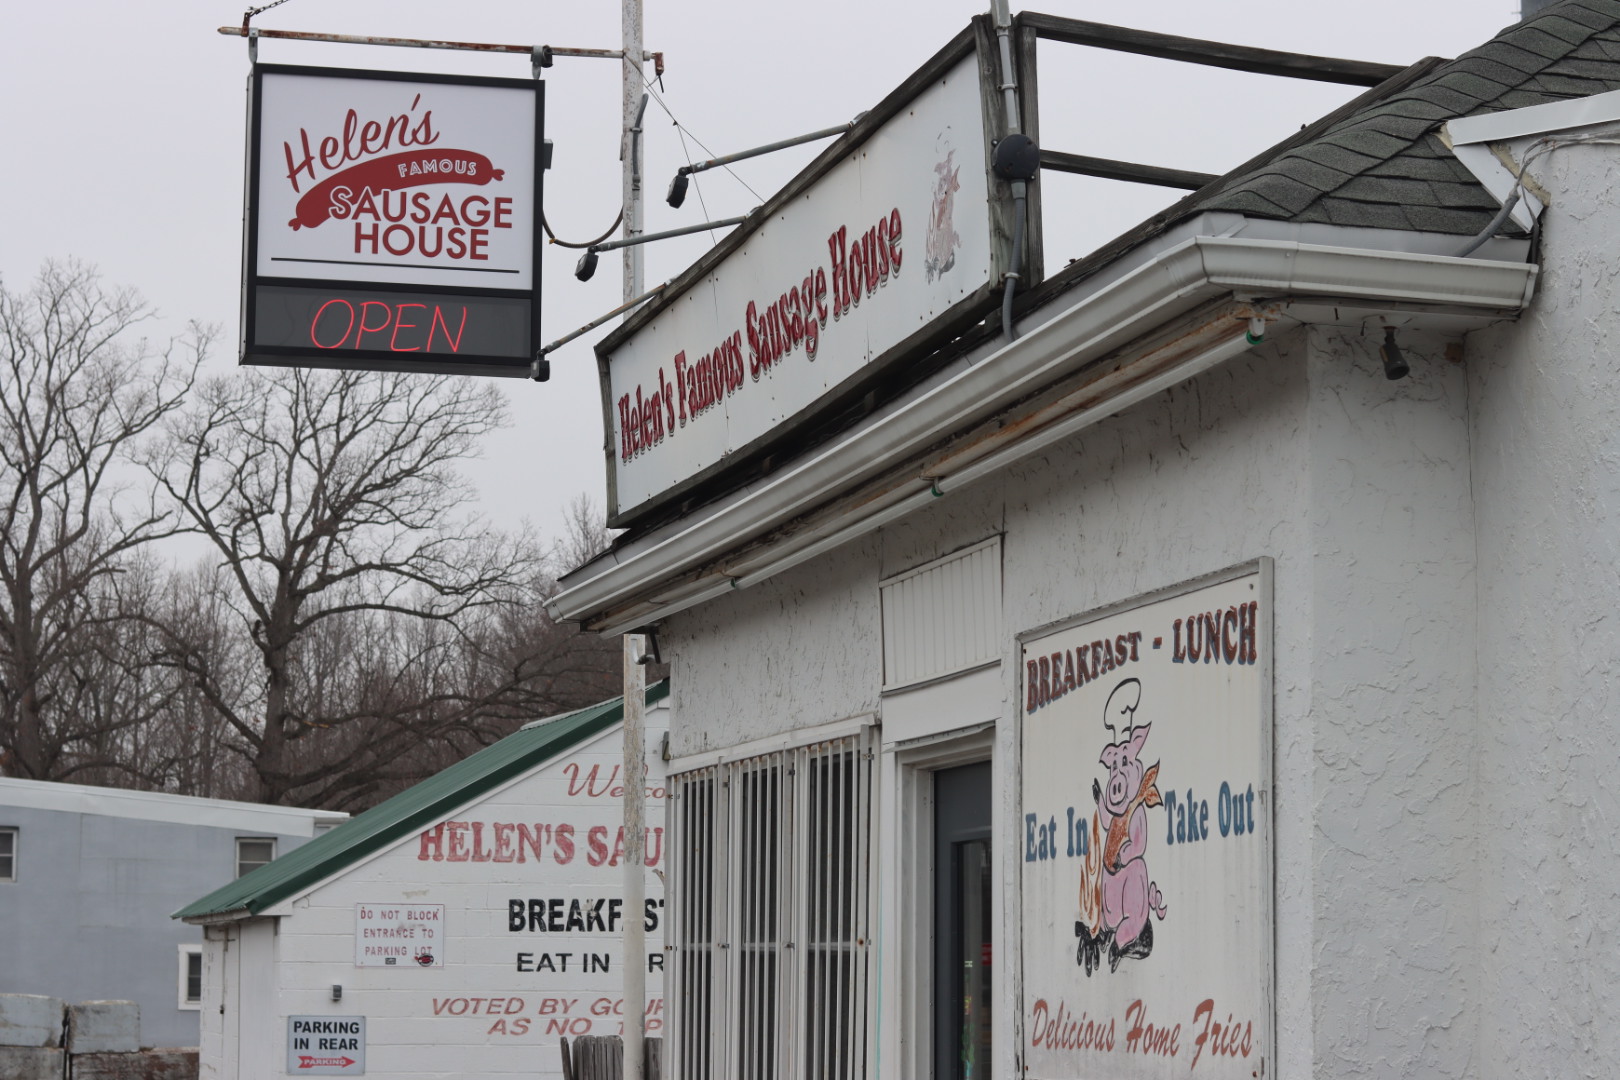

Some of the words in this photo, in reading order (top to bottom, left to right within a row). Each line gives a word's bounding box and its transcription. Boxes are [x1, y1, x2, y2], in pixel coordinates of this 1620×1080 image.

[284, 92, 440, 194] Helen's
[397, 158, 477, 178] FAMOUS
[328, 185, 513, 229] SAUSAGE
[354, 222, 489, 261] HOUSE
[310, 298, 467, 353] OPEN
[618, 366, 676, 466] Helen's
[674, 329, 745, 429] Famous
[745, 266, 828, 383] Sausage
[828, 207, 903, 322] House
[1026, 631, 1142, 715] BREAKFAST
[1172, 601, 1258, 665] LUNCH
[563, 762, 666, 799] Weco
[1025, 813, 1057, 863] Eat
[1066, 806, 1088, 858] In
[1164, 788, 1209, 846] Take
[1218, 780, 1255, 838] Out
[417, 821, 575, 866] HELEN'S
[587, 825, 665, 868] SAU
[360, 909, 373, 920] DO
[380, 910, 400, 920] NOT
[407, 910, 439, 921] BLOCK
[508, 898, 664, 932] BREAKFS
[363, 928, 415, 939] ENTRANCE
[422, 928, 434, 939] TO
[364, 946, 408, 956] PARKING
[414, 946, 433, 956] LOT
[516, 952, 573, 973] EAT
[583, 953, 610, 973] IN
[432, 997, 525, 1016] VOTED
[538, 998, 579, 1016] BY
[293, 1021, 360, 1034] PARKING
[294, 1037, 309, 1050] IN
[318, 1038, 359, 1050] REAR
[487, 1018, 532, 1036] AS
[545, 1017, 593, 1036] NO
[1031, 998, 1116, 1052] Delicious
[1125, 998, 1182, 1057] Home
[1190, 998, 1253, 1072] Fries
